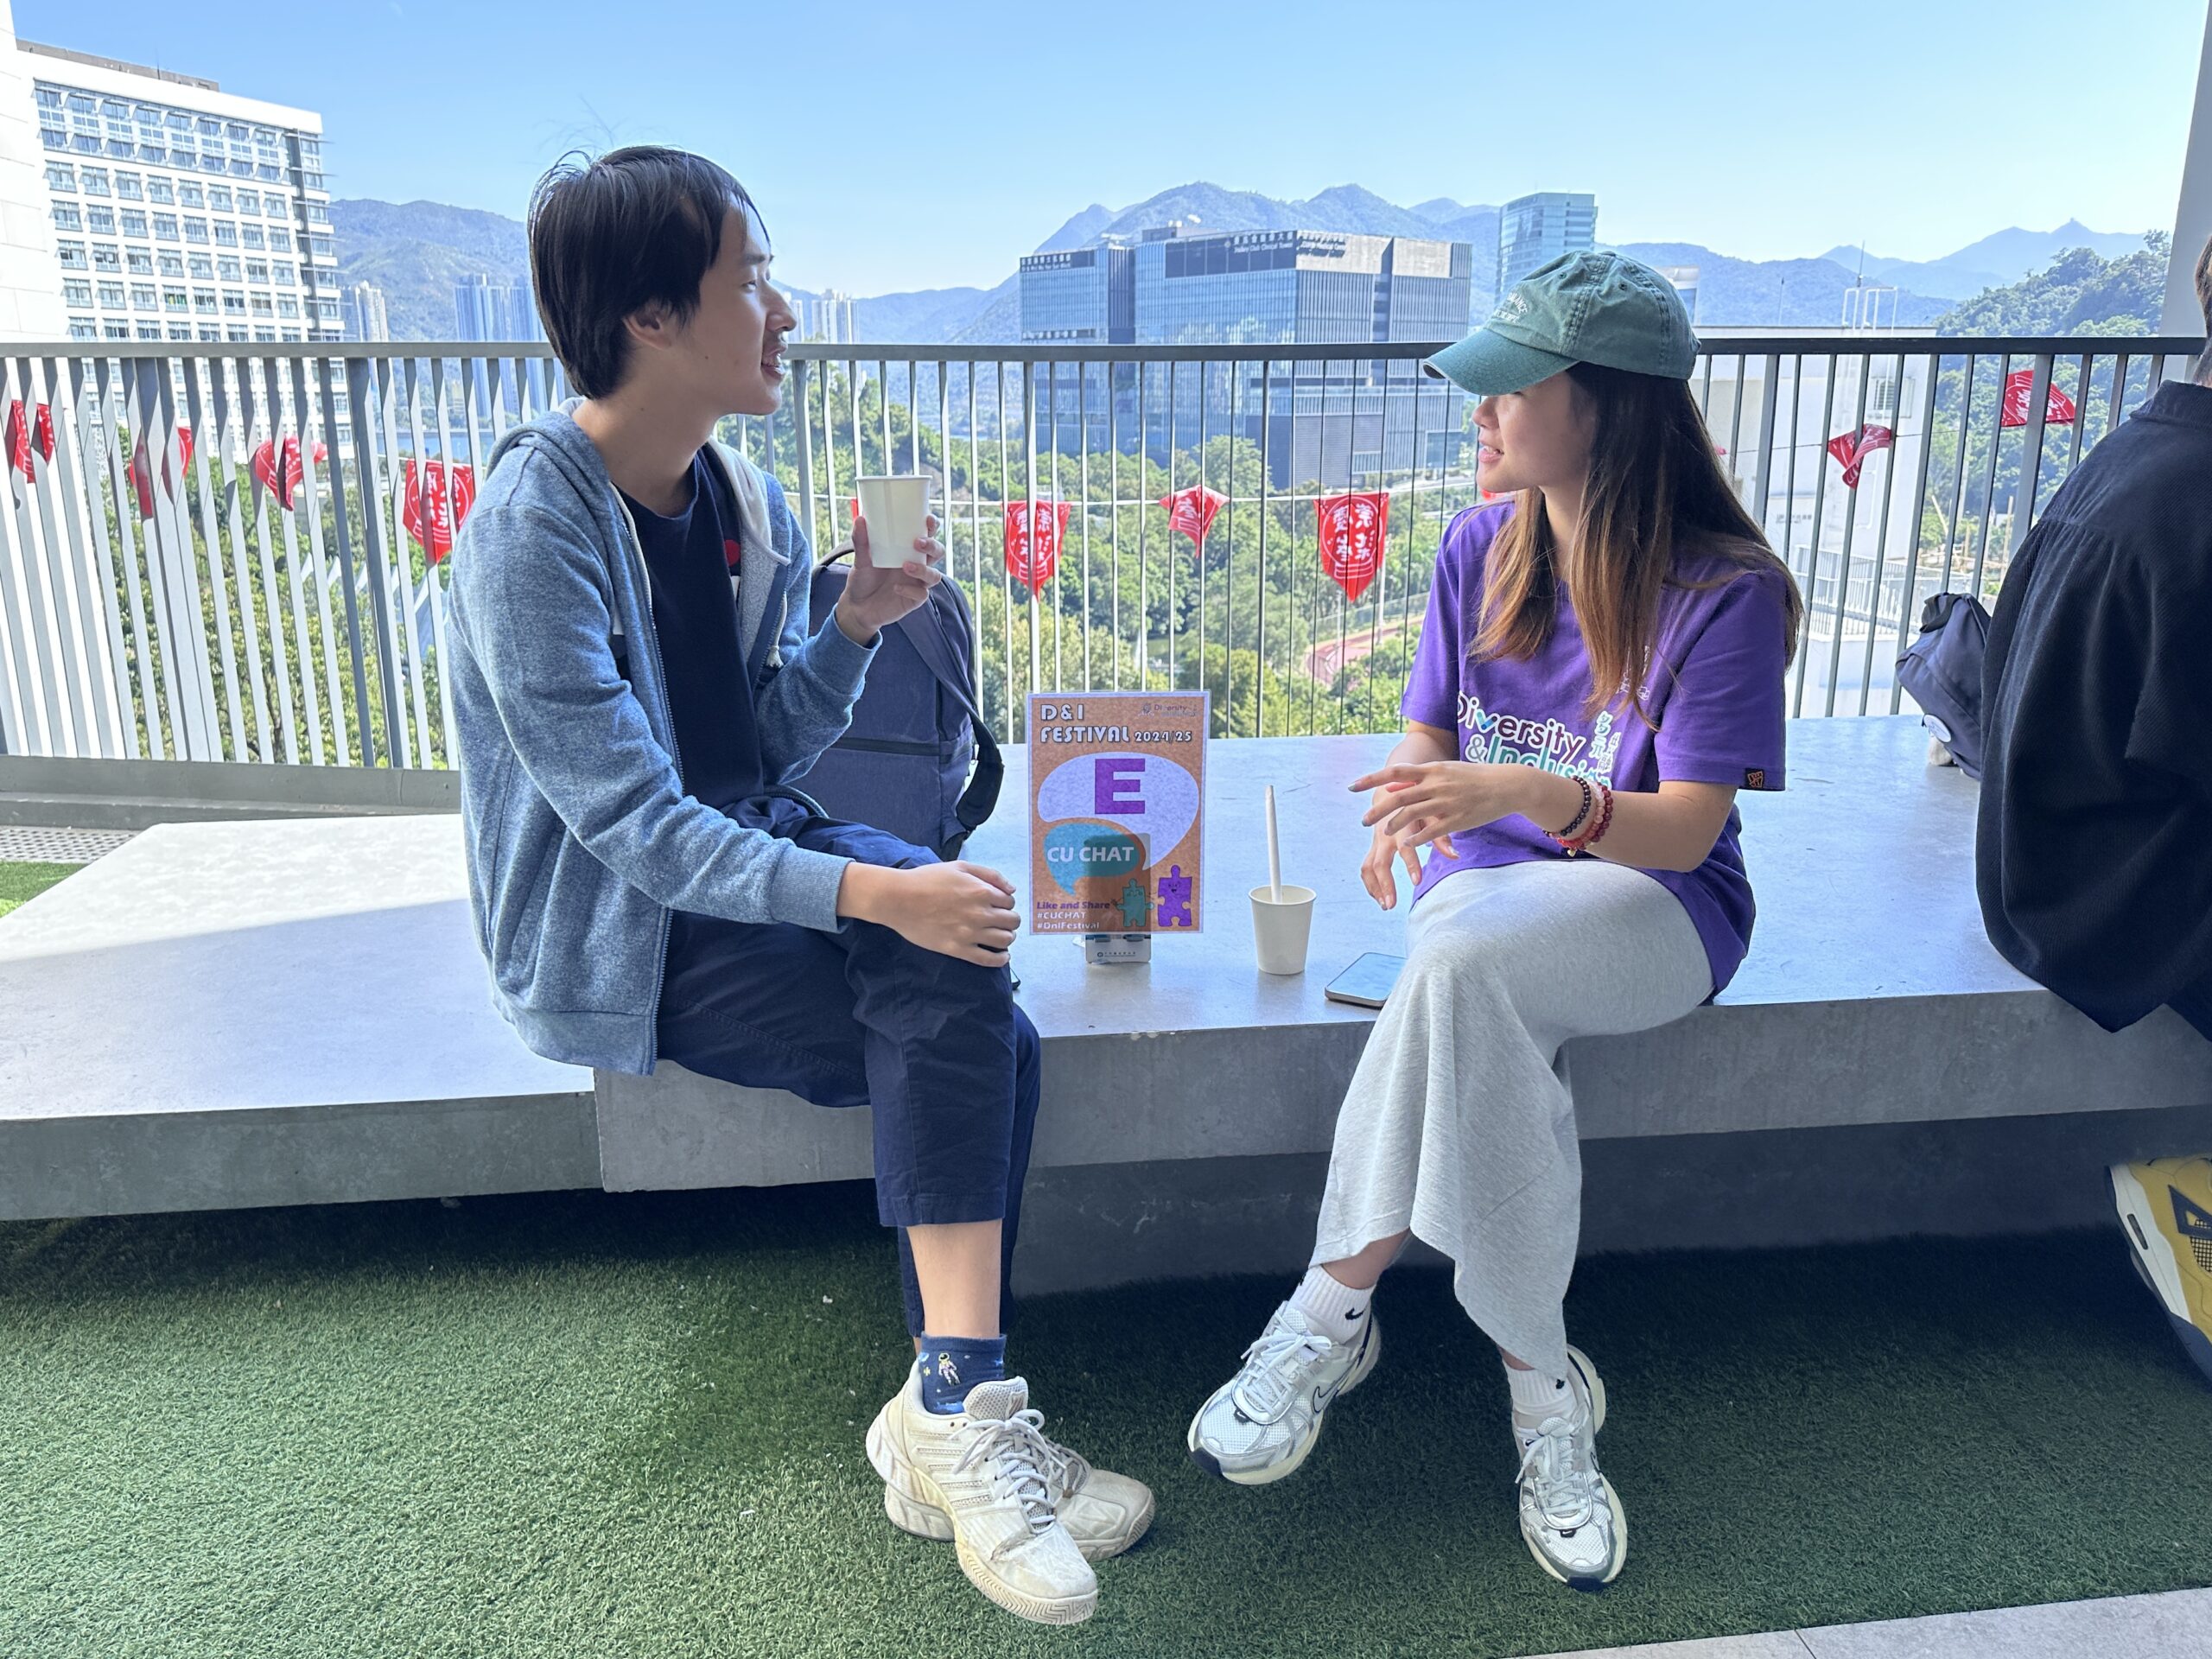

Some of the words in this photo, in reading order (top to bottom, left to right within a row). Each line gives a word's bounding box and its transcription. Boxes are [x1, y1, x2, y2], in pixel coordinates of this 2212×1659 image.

[1039, 725, 1131, 744] FESTIVAL
[1134, 729, 1193, 744] 2024/25
[1589, 710, 1613, 760] 多元
[1094, 758, 1146, 815] E
[1046, 845, 1074, 863] CU
[1077, 845, 1135, 863] CHAT
[1037, 901, 1058, 910] Like
[1060, 901, 1080, 910] and
[1081, 901, 1111, 910] Share
[1037, 911, 1087, 920] #CUCHAT
